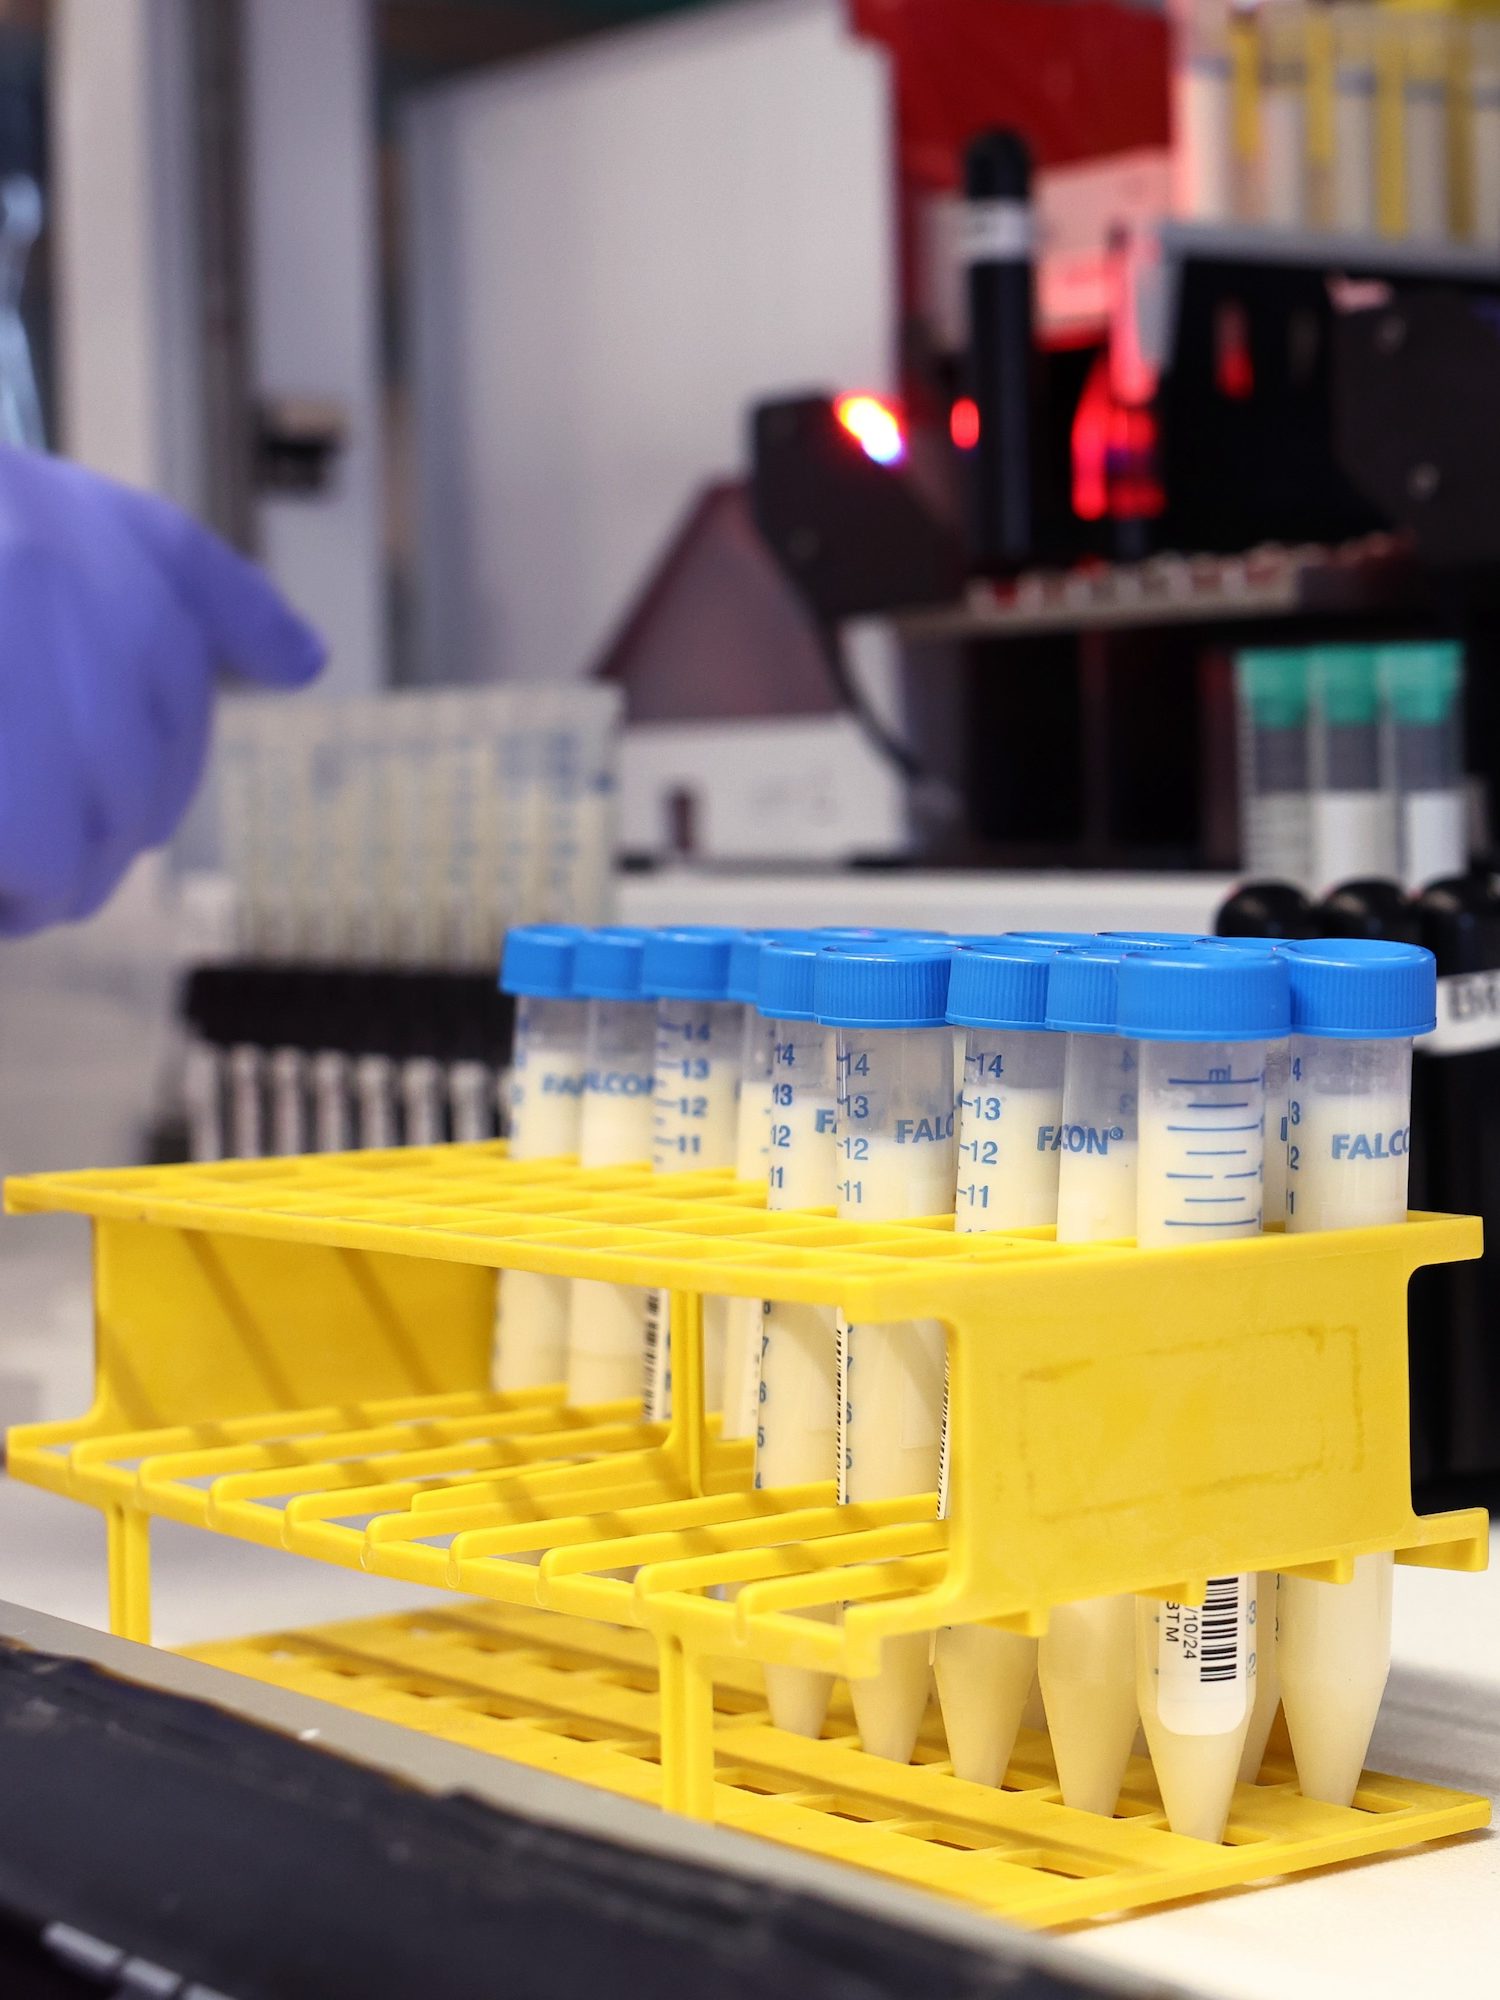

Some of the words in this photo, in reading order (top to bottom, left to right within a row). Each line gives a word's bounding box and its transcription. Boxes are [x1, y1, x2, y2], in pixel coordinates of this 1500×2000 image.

[777, 1043, 795, 1066] 14
[845, 1053, 870, 1077] 14
[976, 1053, 1004, 1078] 14
[682, 1058, 710, 1080] 13
[1208, 1065, 1232, 1081] ml
[773, 1084, 792, 1106] 13
[680, 1096, 708, 1118] 12
[845, 1095, 869, 1119] 13
[973, 1096, 1001, 1121] 13
[678, 1136, 701, 1153] 11
[771, 1125, 791, 1147] 12
[843, 1137, 869, 1161] 12
[970, 1140, 999, 1165] 12
[769, 1166, 784, 1188] 11
[843, 1179, 863, 1203] 11
[967, 1184, 989, 1208] 11
